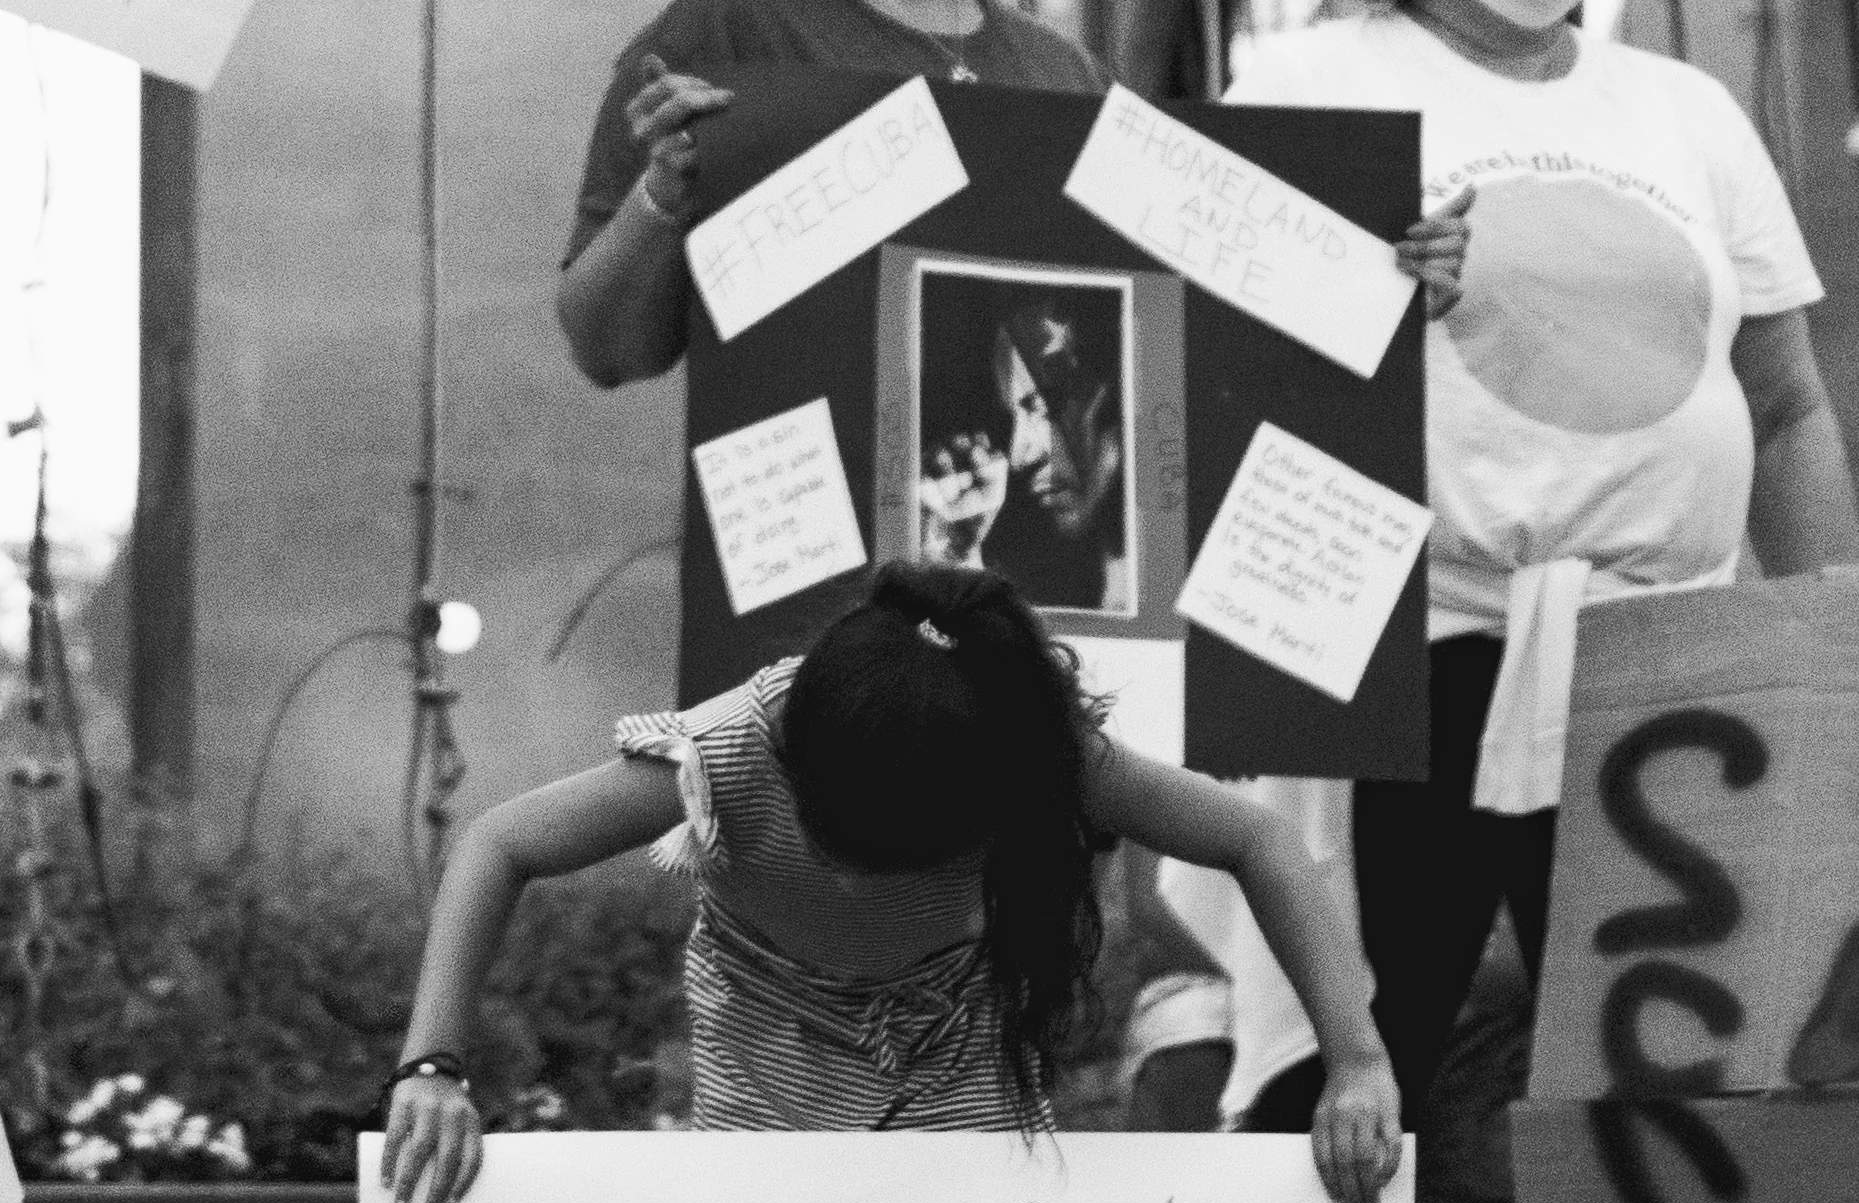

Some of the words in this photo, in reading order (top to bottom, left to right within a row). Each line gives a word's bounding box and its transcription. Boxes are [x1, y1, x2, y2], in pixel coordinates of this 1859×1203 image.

[704, 100, 942, 300] #FREECUBA
[1114, 99, 1347, 261] #HOMELAND
[1177, 194, 1260, 251] AND
[1137, 204, 1274, 303] LIFE
